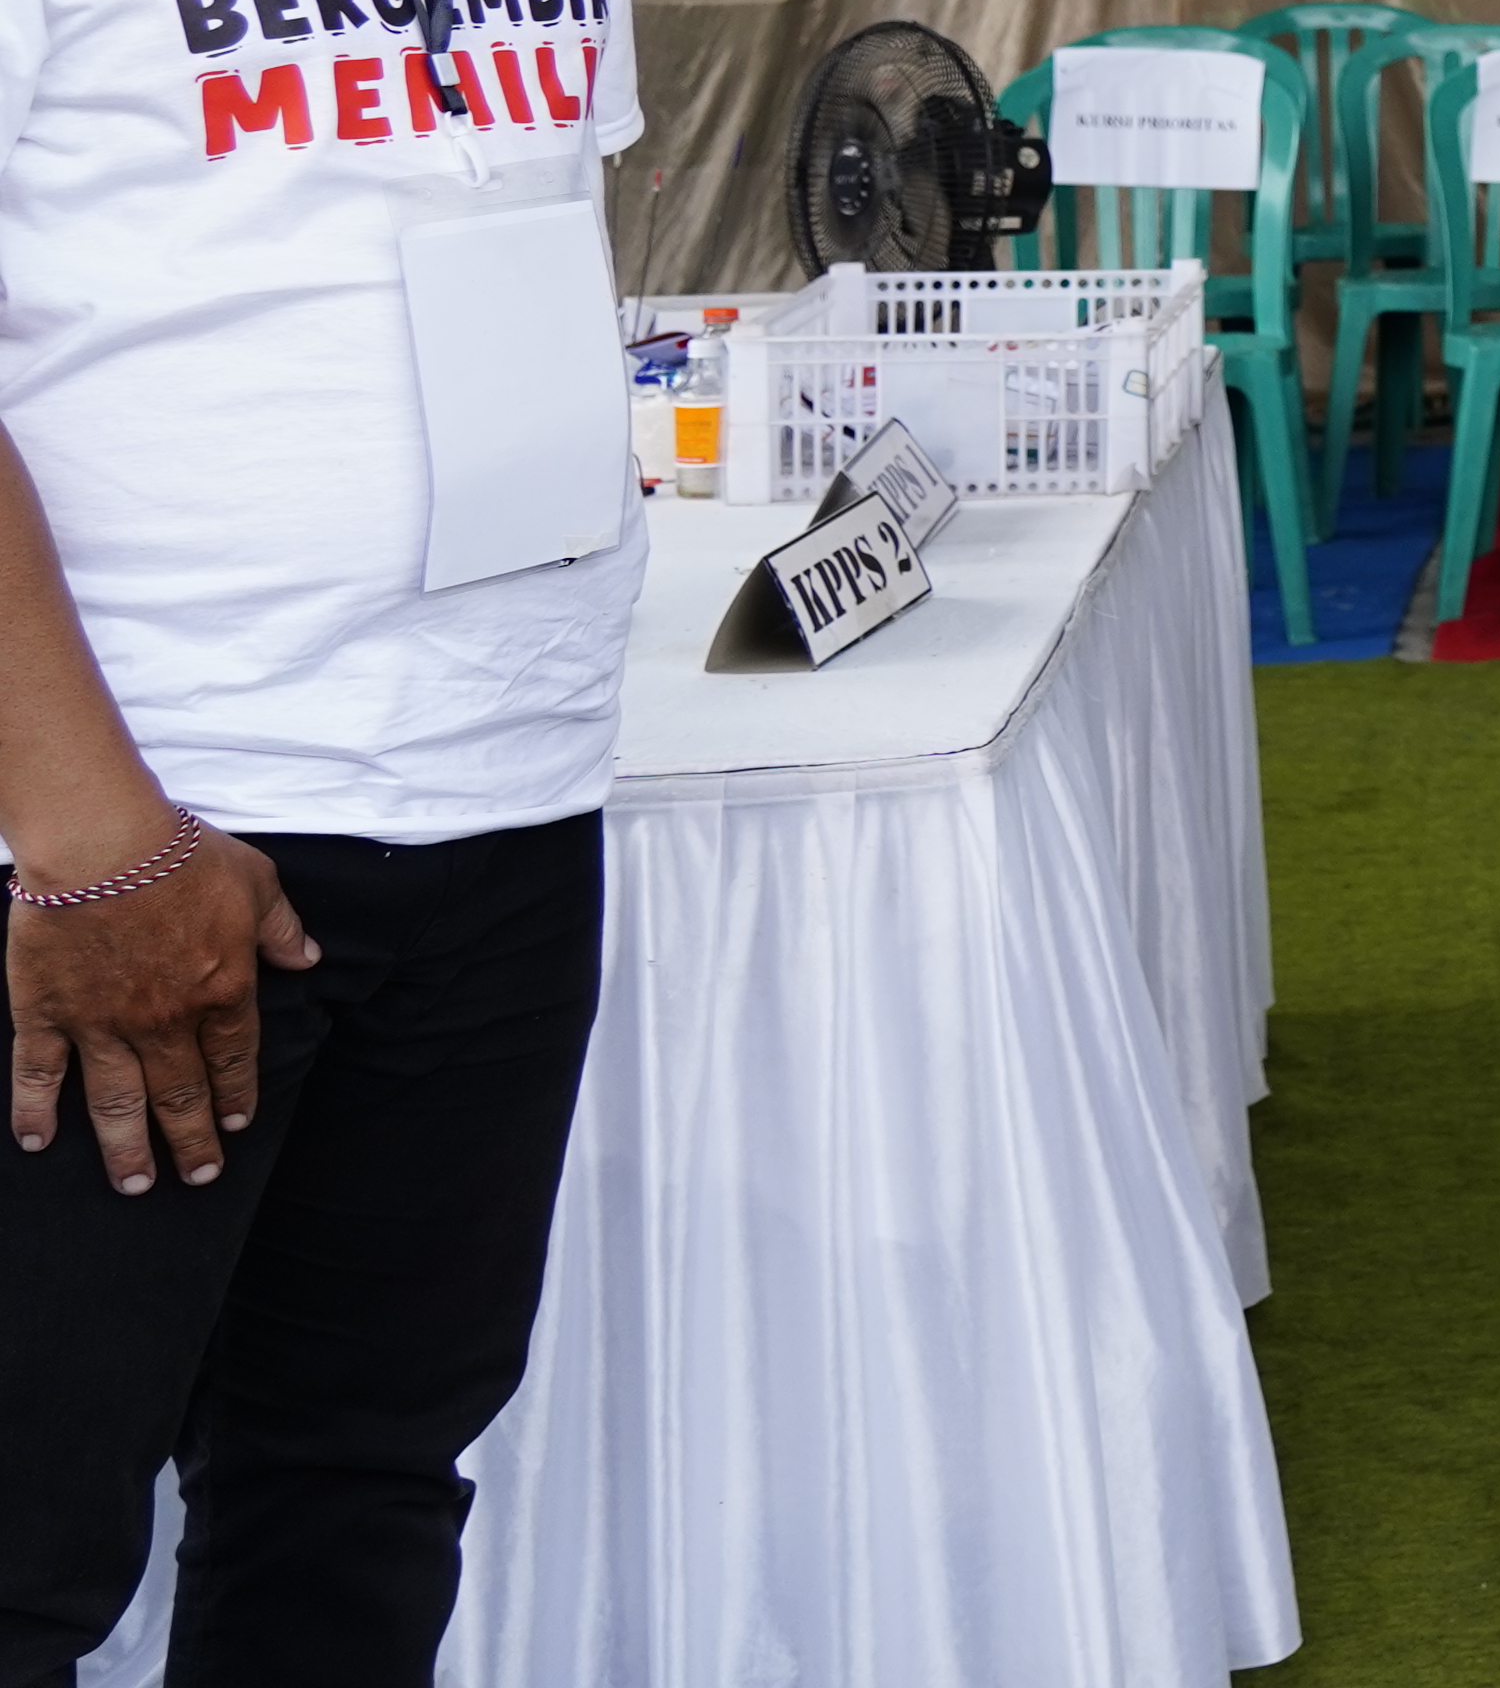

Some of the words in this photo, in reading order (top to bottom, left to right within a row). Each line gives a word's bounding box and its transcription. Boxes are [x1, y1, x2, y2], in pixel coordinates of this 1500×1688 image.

[905, 443, 938, 488] 1
[790, 534, 888, 635] KPPS
[879, 520, 914, 576] 2
